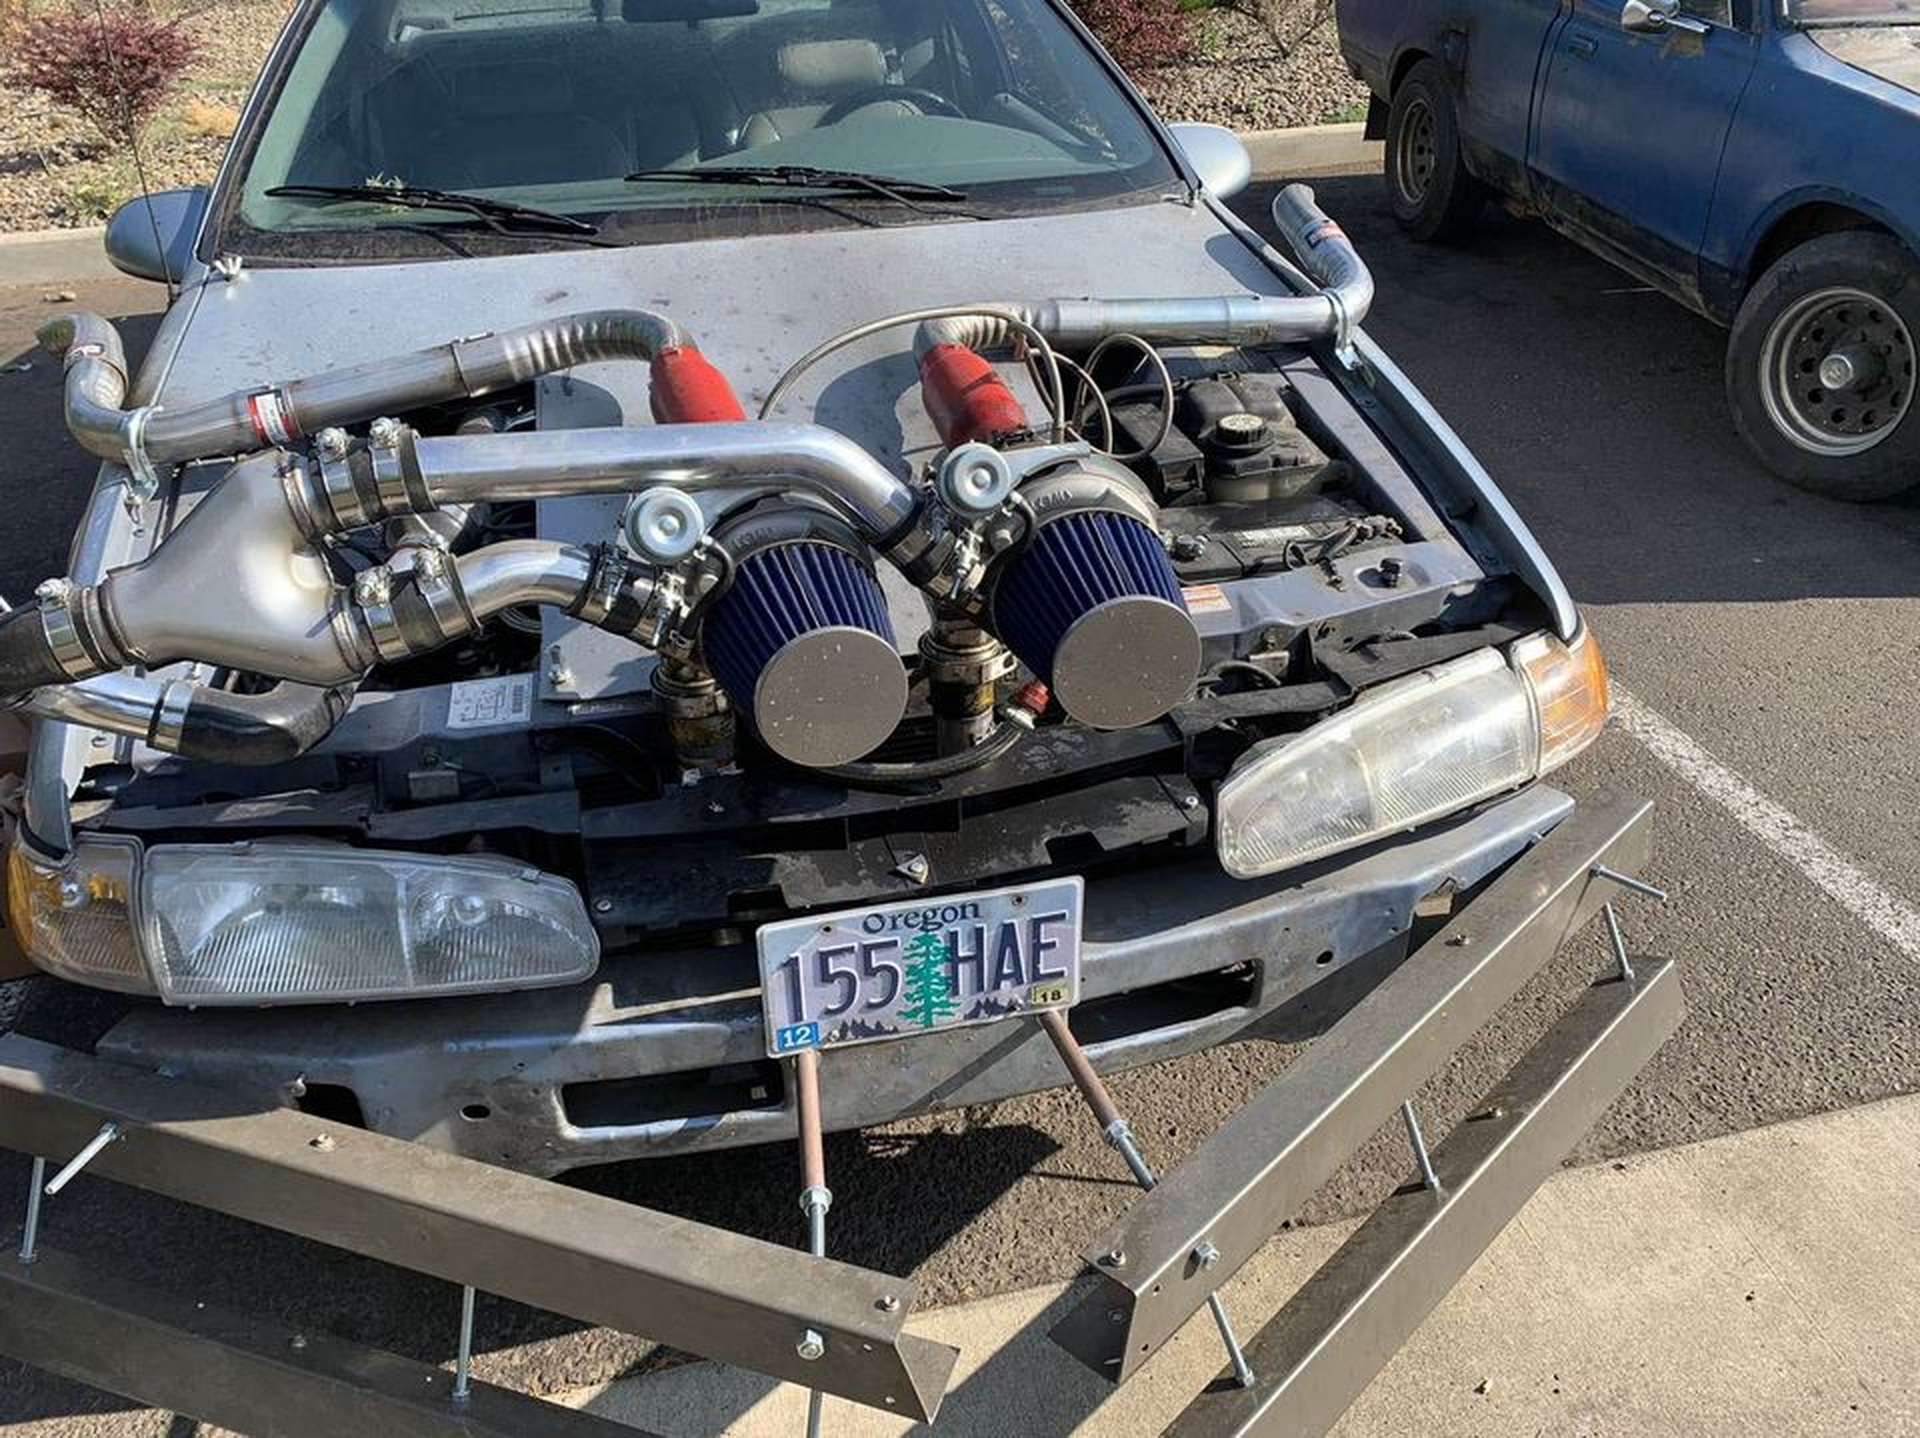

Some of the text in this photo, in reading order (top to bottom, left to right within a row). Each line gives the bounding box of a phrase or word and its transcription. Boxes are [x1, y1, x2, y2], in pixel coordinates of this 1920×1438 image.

[863, 900, 981, 932] Oregon
[778, 911, 1068, 1023] 155 HAE
[1040, 989, 1062, 1002] 18
[783, 1026, 812, 1048] 12
